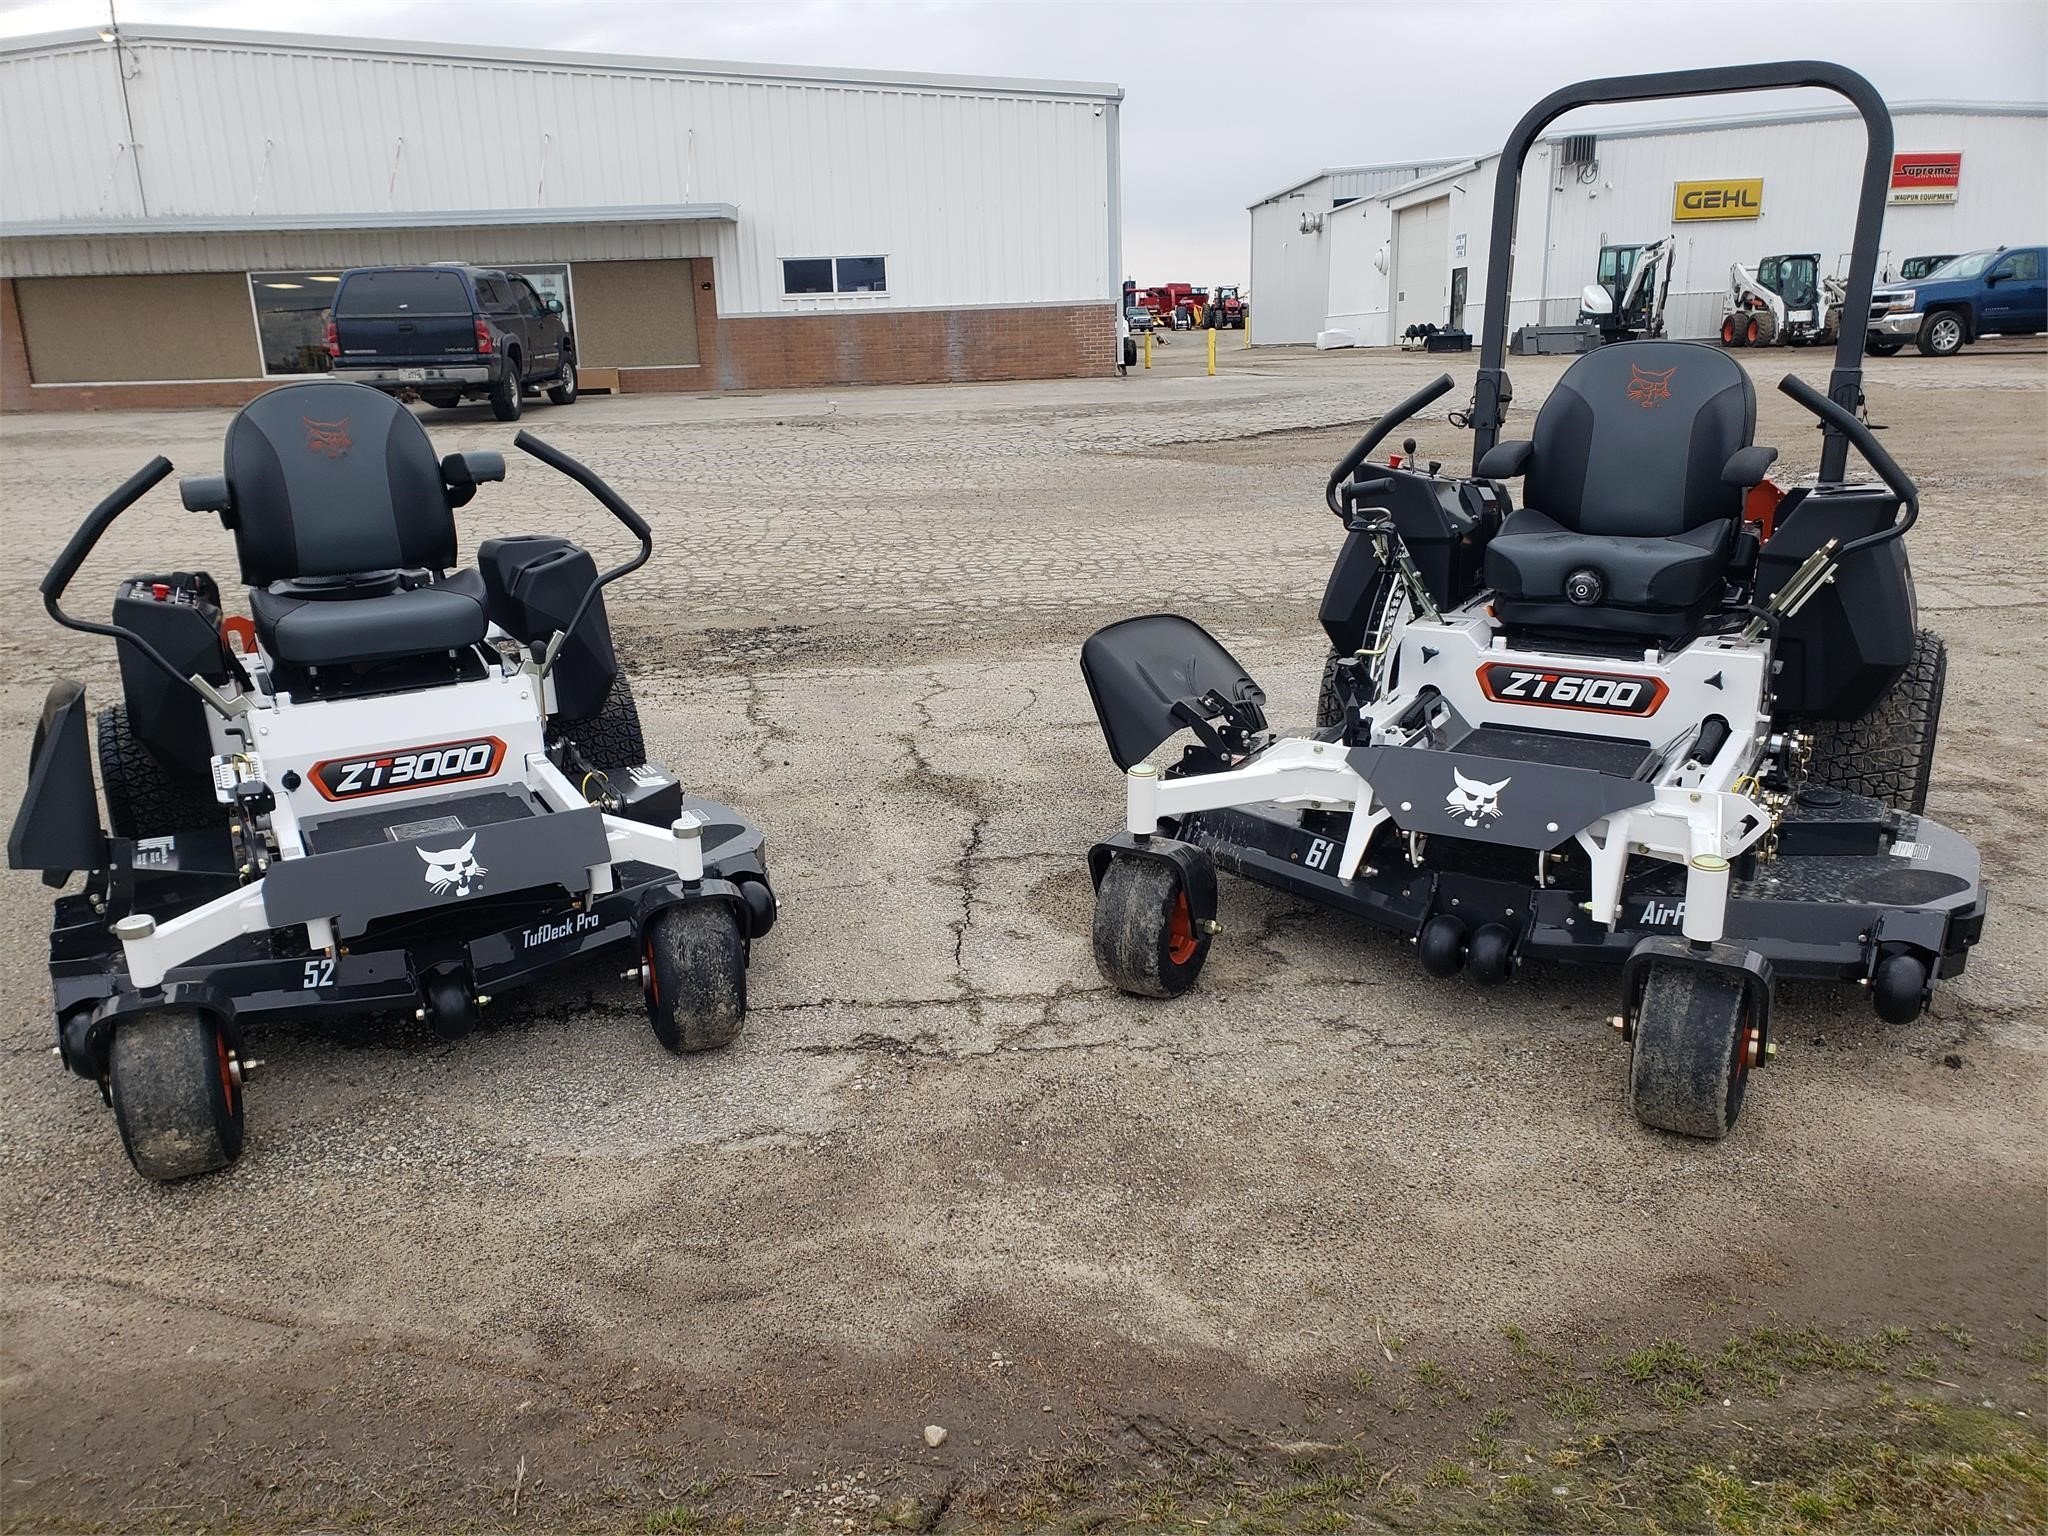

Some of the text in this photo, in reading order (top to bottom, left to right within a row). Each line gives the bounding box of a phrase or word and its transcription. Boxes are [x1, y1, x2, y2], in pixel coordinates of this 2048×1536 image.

[1901, 164, 1952, 177] Supreme
[1683, 189, 1758, 209] GEHL
[1894, 193, 1953, 201] WAUPUN EQUIPMENT
[1501, 671, 1643, 708] ZT6100
[335, 744, 492, 793] ZT3000
[1304, 838, 1335, 870] 61
[522, 913, 599, 949] TufDeck Pro
[303, 959, 334, 989] 52
